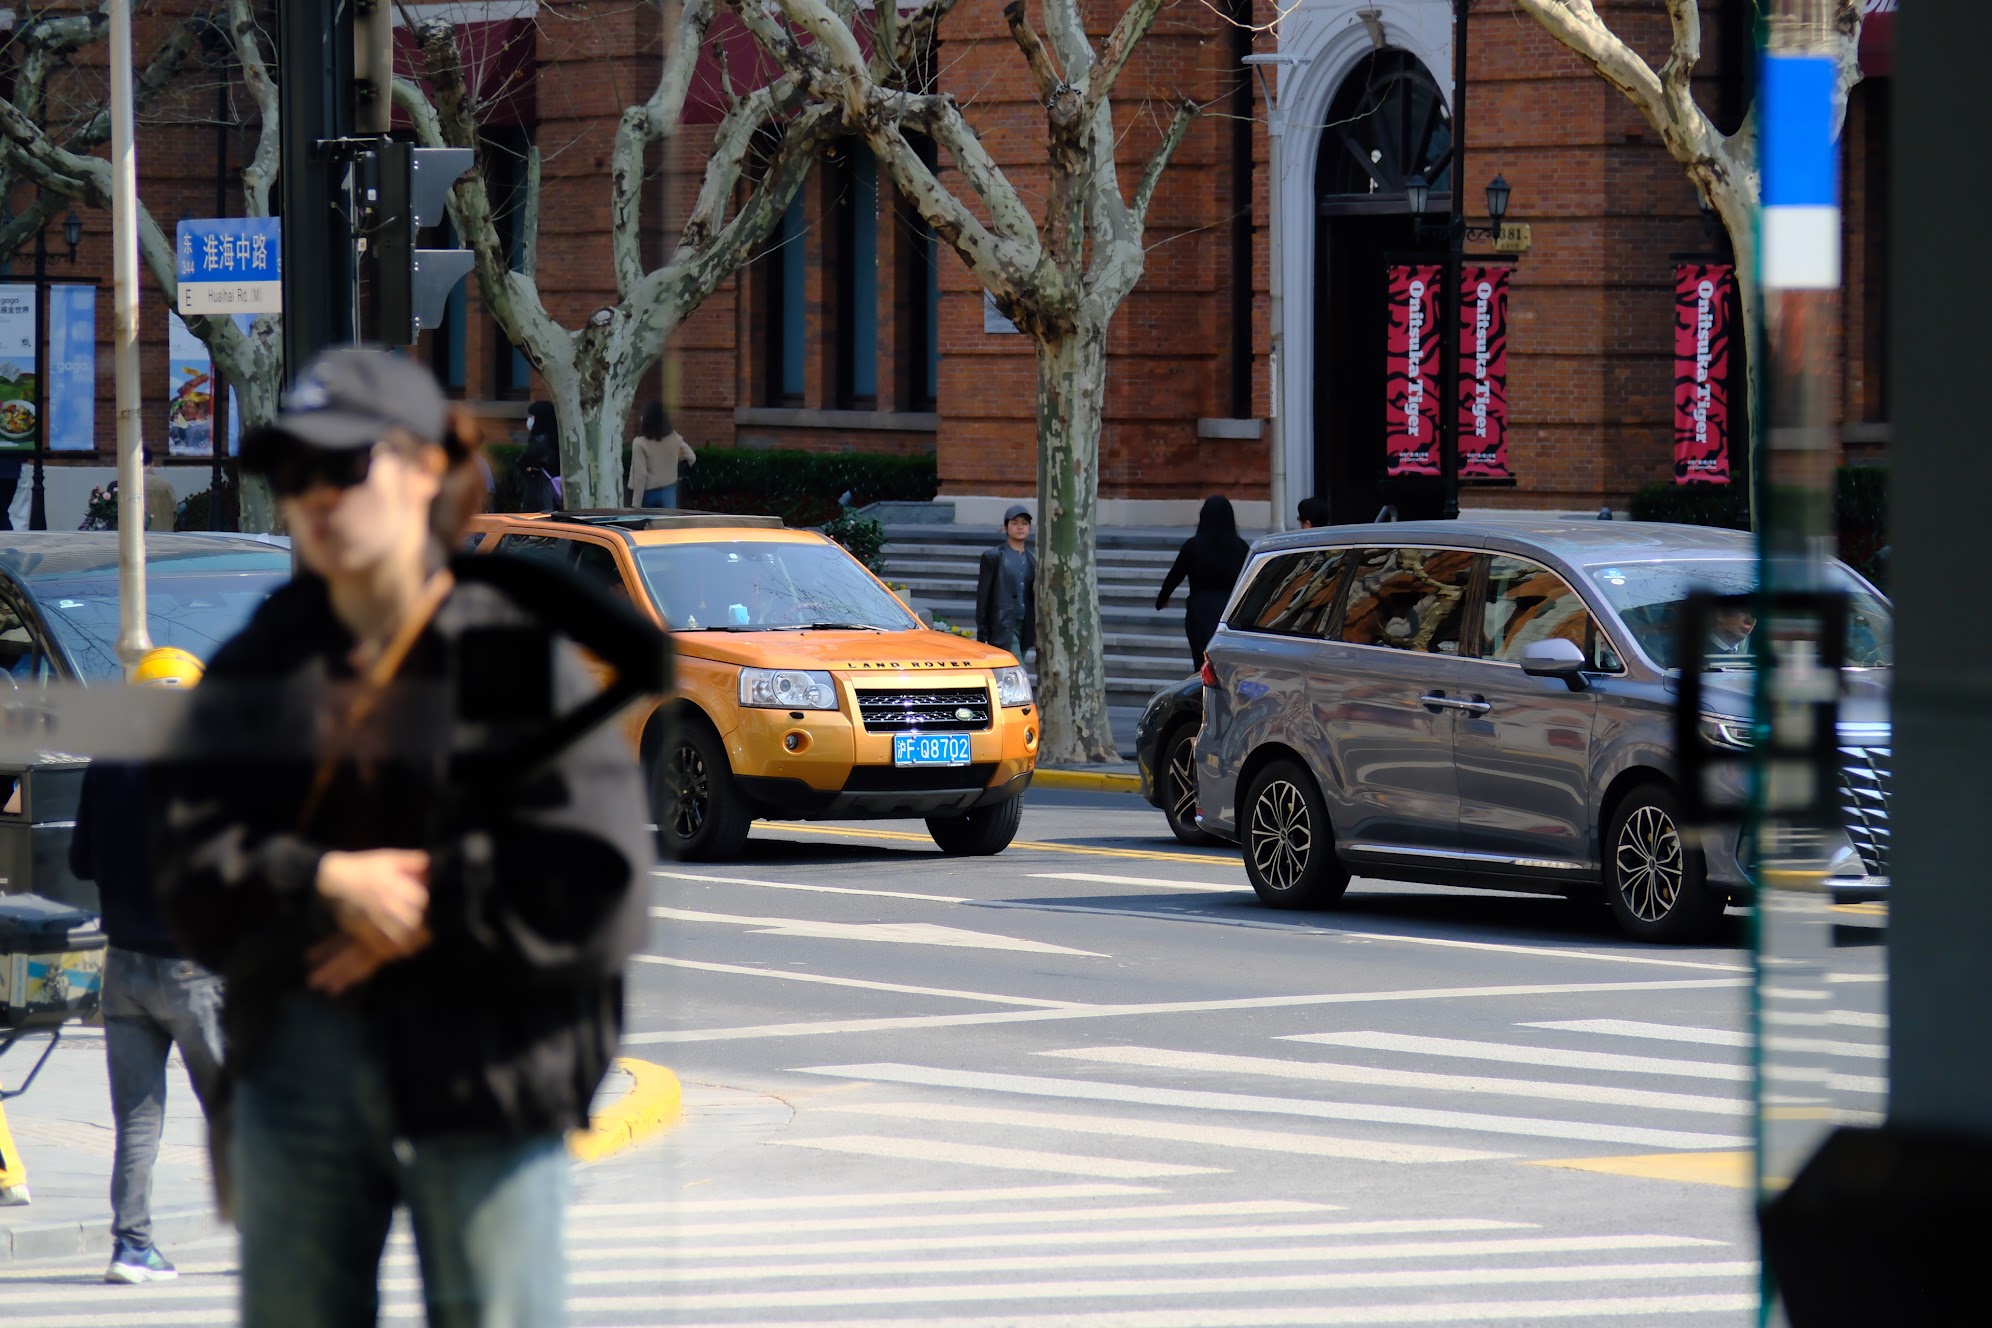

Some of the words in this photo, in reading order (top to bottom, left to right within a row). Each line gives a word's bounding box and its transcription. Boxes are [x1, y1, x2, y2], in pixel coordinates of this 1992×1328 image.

[182, 260, 194, 274] 344
[183, 232, 193, 254] 东
[203, 233, 267, 271] 淮海中路
[186, 289, 191, 306] E
[208, 288, 234, 302] Huaihai
[238, 288, 249, 302] Rd.
[251, 287, 262, 303] (M)
[1407, 281, 1425, 378] Onitsuka
[1475, 281, 1492, 379] Onitsuka
[1697, 281, 1714, 382] Onitsuka
[56, 360, 88, 373] gaga
[1405, 380, 1423, 437] Tiger
[1472, 381, 1490, 438] Tiger
[1693, 383, 1711, 443] Tiger
